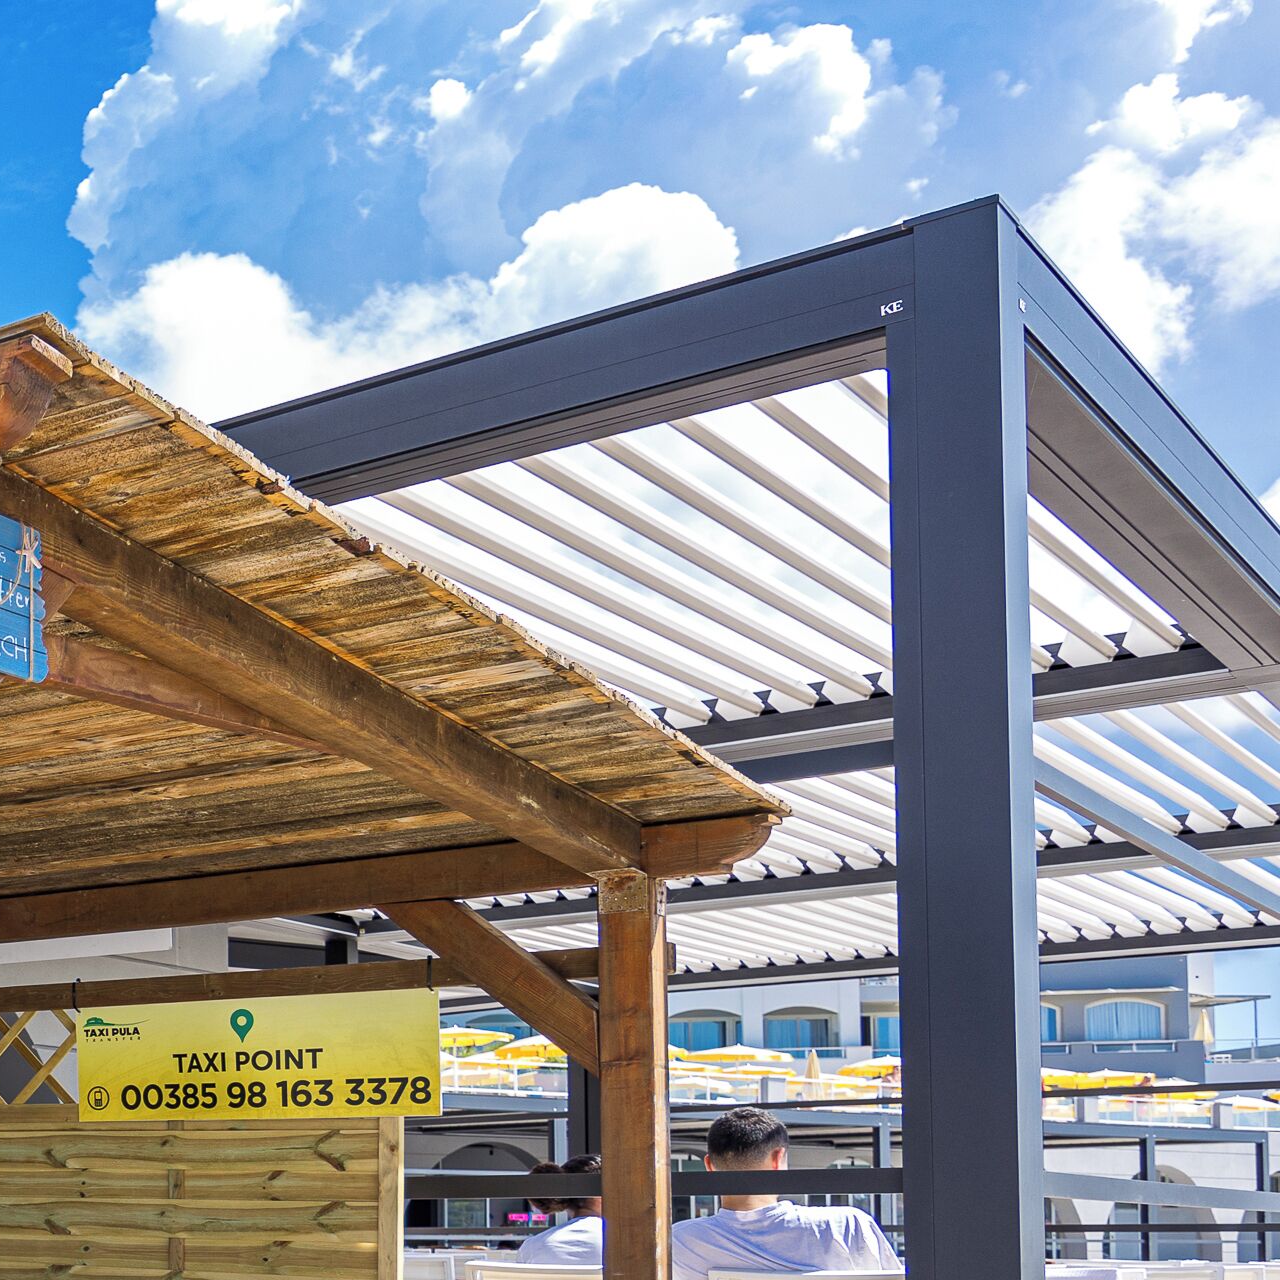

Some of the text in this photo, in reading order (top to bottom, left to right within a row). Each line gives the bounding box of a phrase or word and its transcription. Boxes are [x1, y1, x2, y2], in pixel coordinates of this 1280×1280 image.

[880, 299, 904, 317] KE
[84, 1027, 140, 1037] TAXI PULA
[173, 1047, 323, 1074] TAXI POINT
[121, 1075, 432, 1111] 00385 98 163 3378
